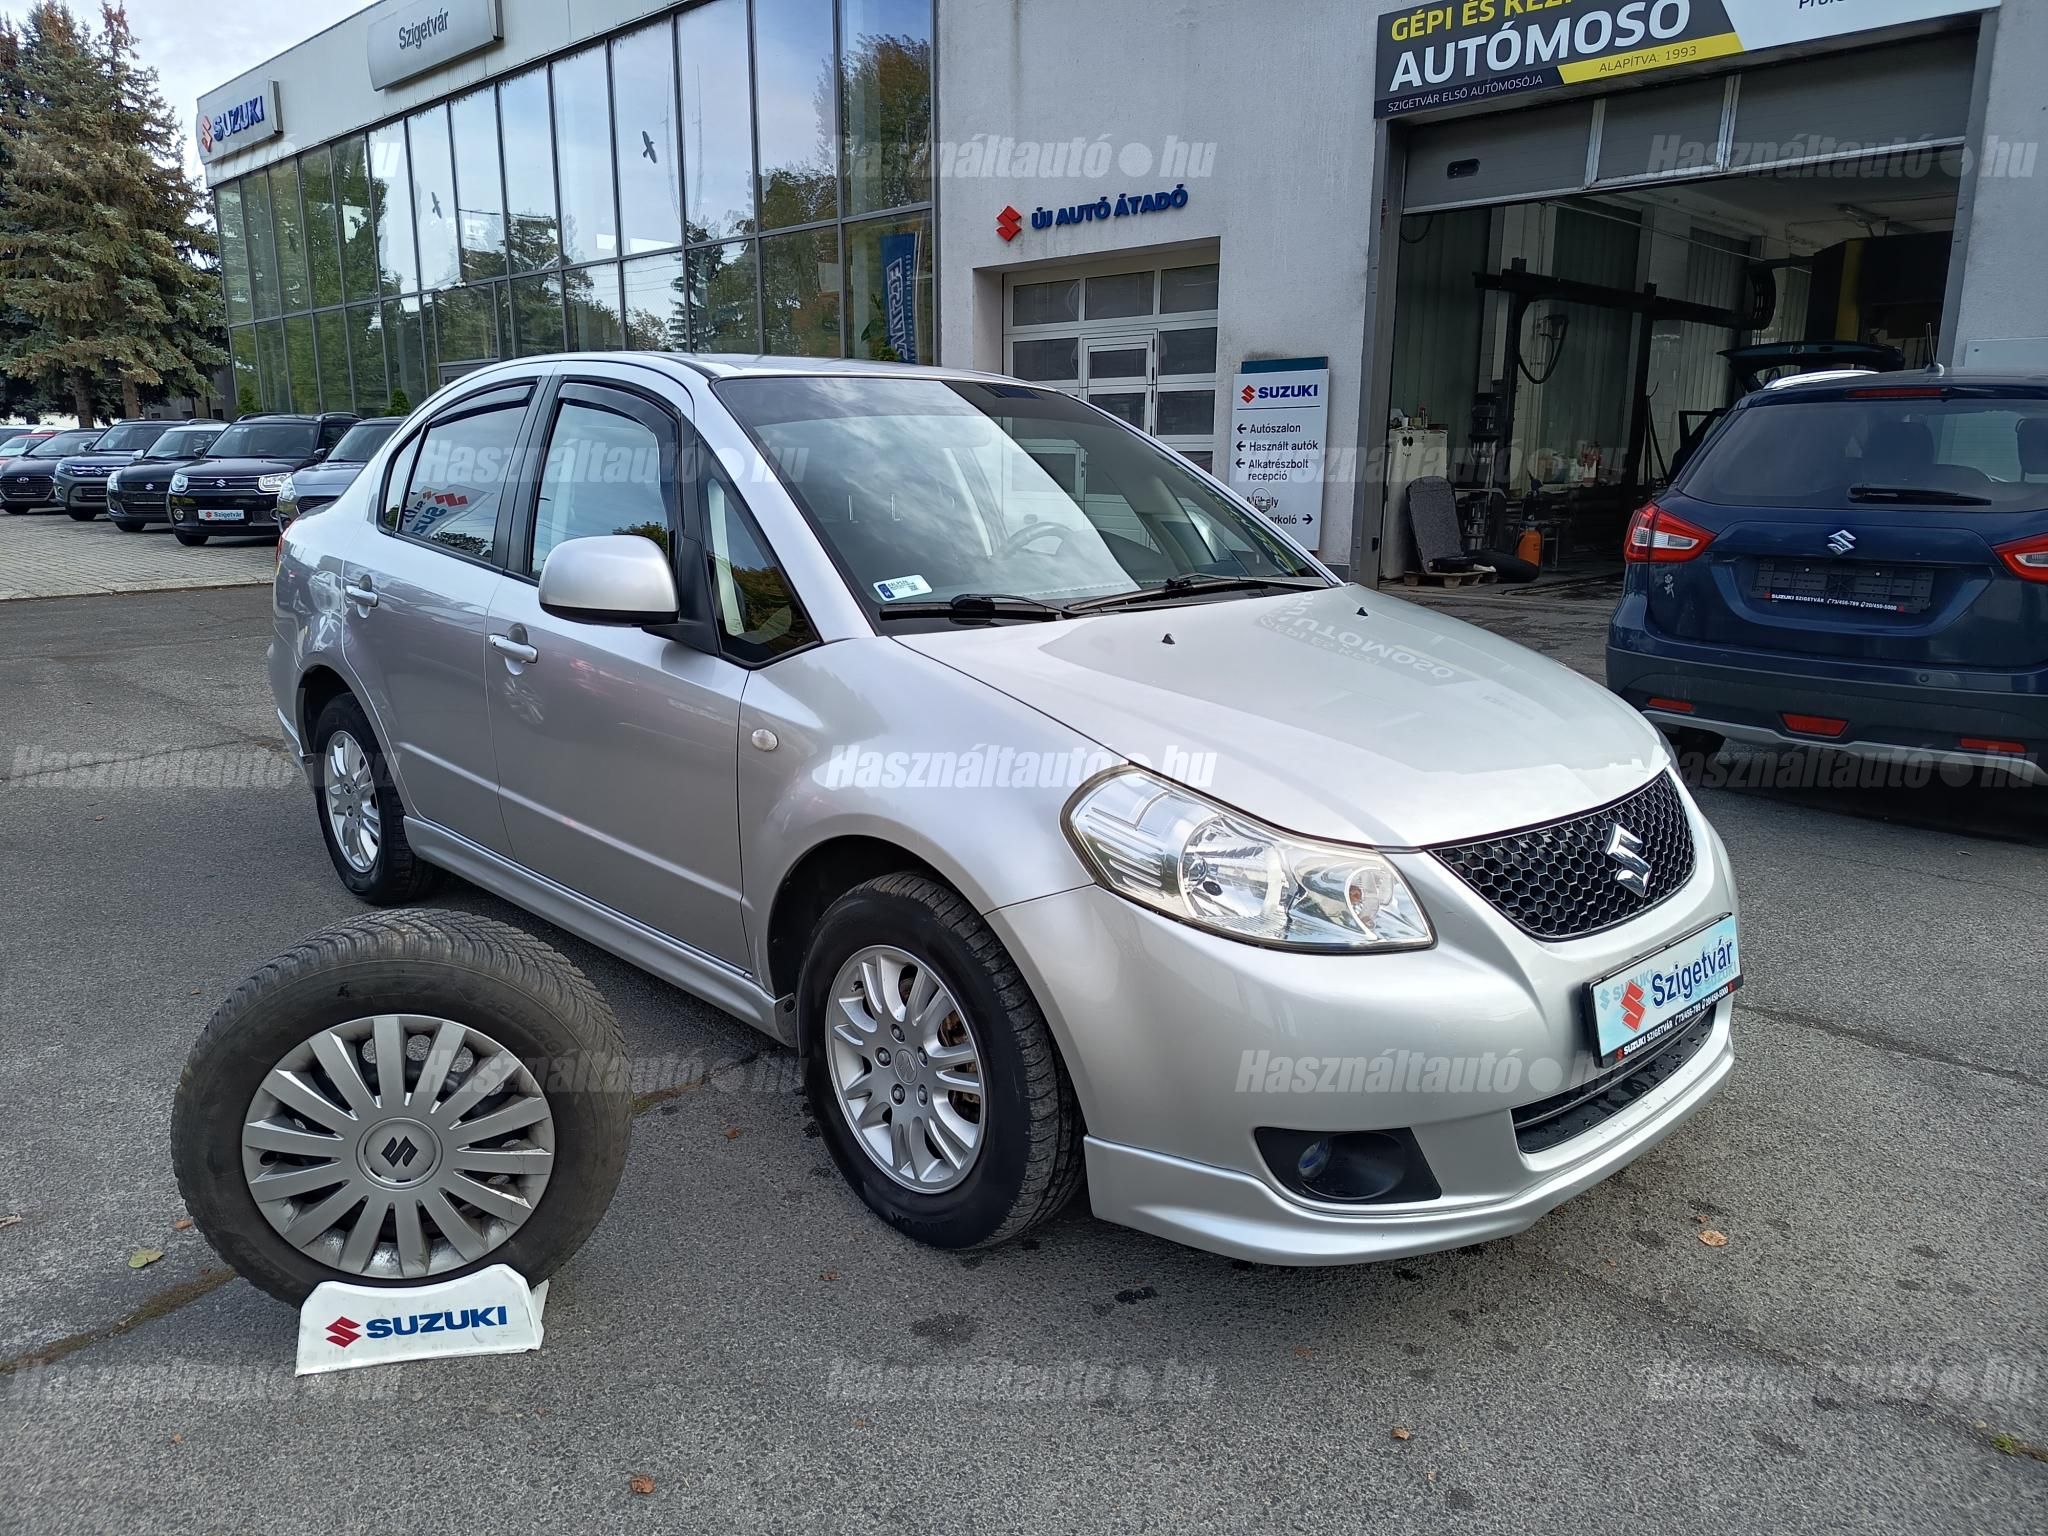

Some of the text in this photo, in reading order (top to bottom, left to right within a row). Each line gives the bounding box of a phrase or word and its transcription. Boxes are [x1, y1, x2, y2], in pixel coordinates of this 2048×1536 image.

[398, 8, 449, 50] Szigetvár
[1391, 8, 1452, 41] GÉPI
[1665, 45, 1697, 61] 1993
[1387, 94, 1440, 113] SZIGETVÁR
[1470, 74, 1543, 97] AUTÓMOSÓJA
[212, 95, 265, 142] SUZUKI
[1031, 183, 1189, 230] ÚJ AUTÓ ÁTADÓ
[1257, 384, 1319, 399] SUZUKI
[1249, 423, 1301, 434] Autószalon
[1249, 440, 1319, 452] Használt autók
[1248, 459, 1309, 469] Alkatrészbolt
[1248, 470, 1288, 482] recepció
[1651, 939, 1733, 1007] Szigetvár
[1623, 1037, 1647, 1056] SUZUKI
[1646, 1019, 1673, 1042] SZIGETVÁR
[365, 1306, 508, 1339] SUZUKI
